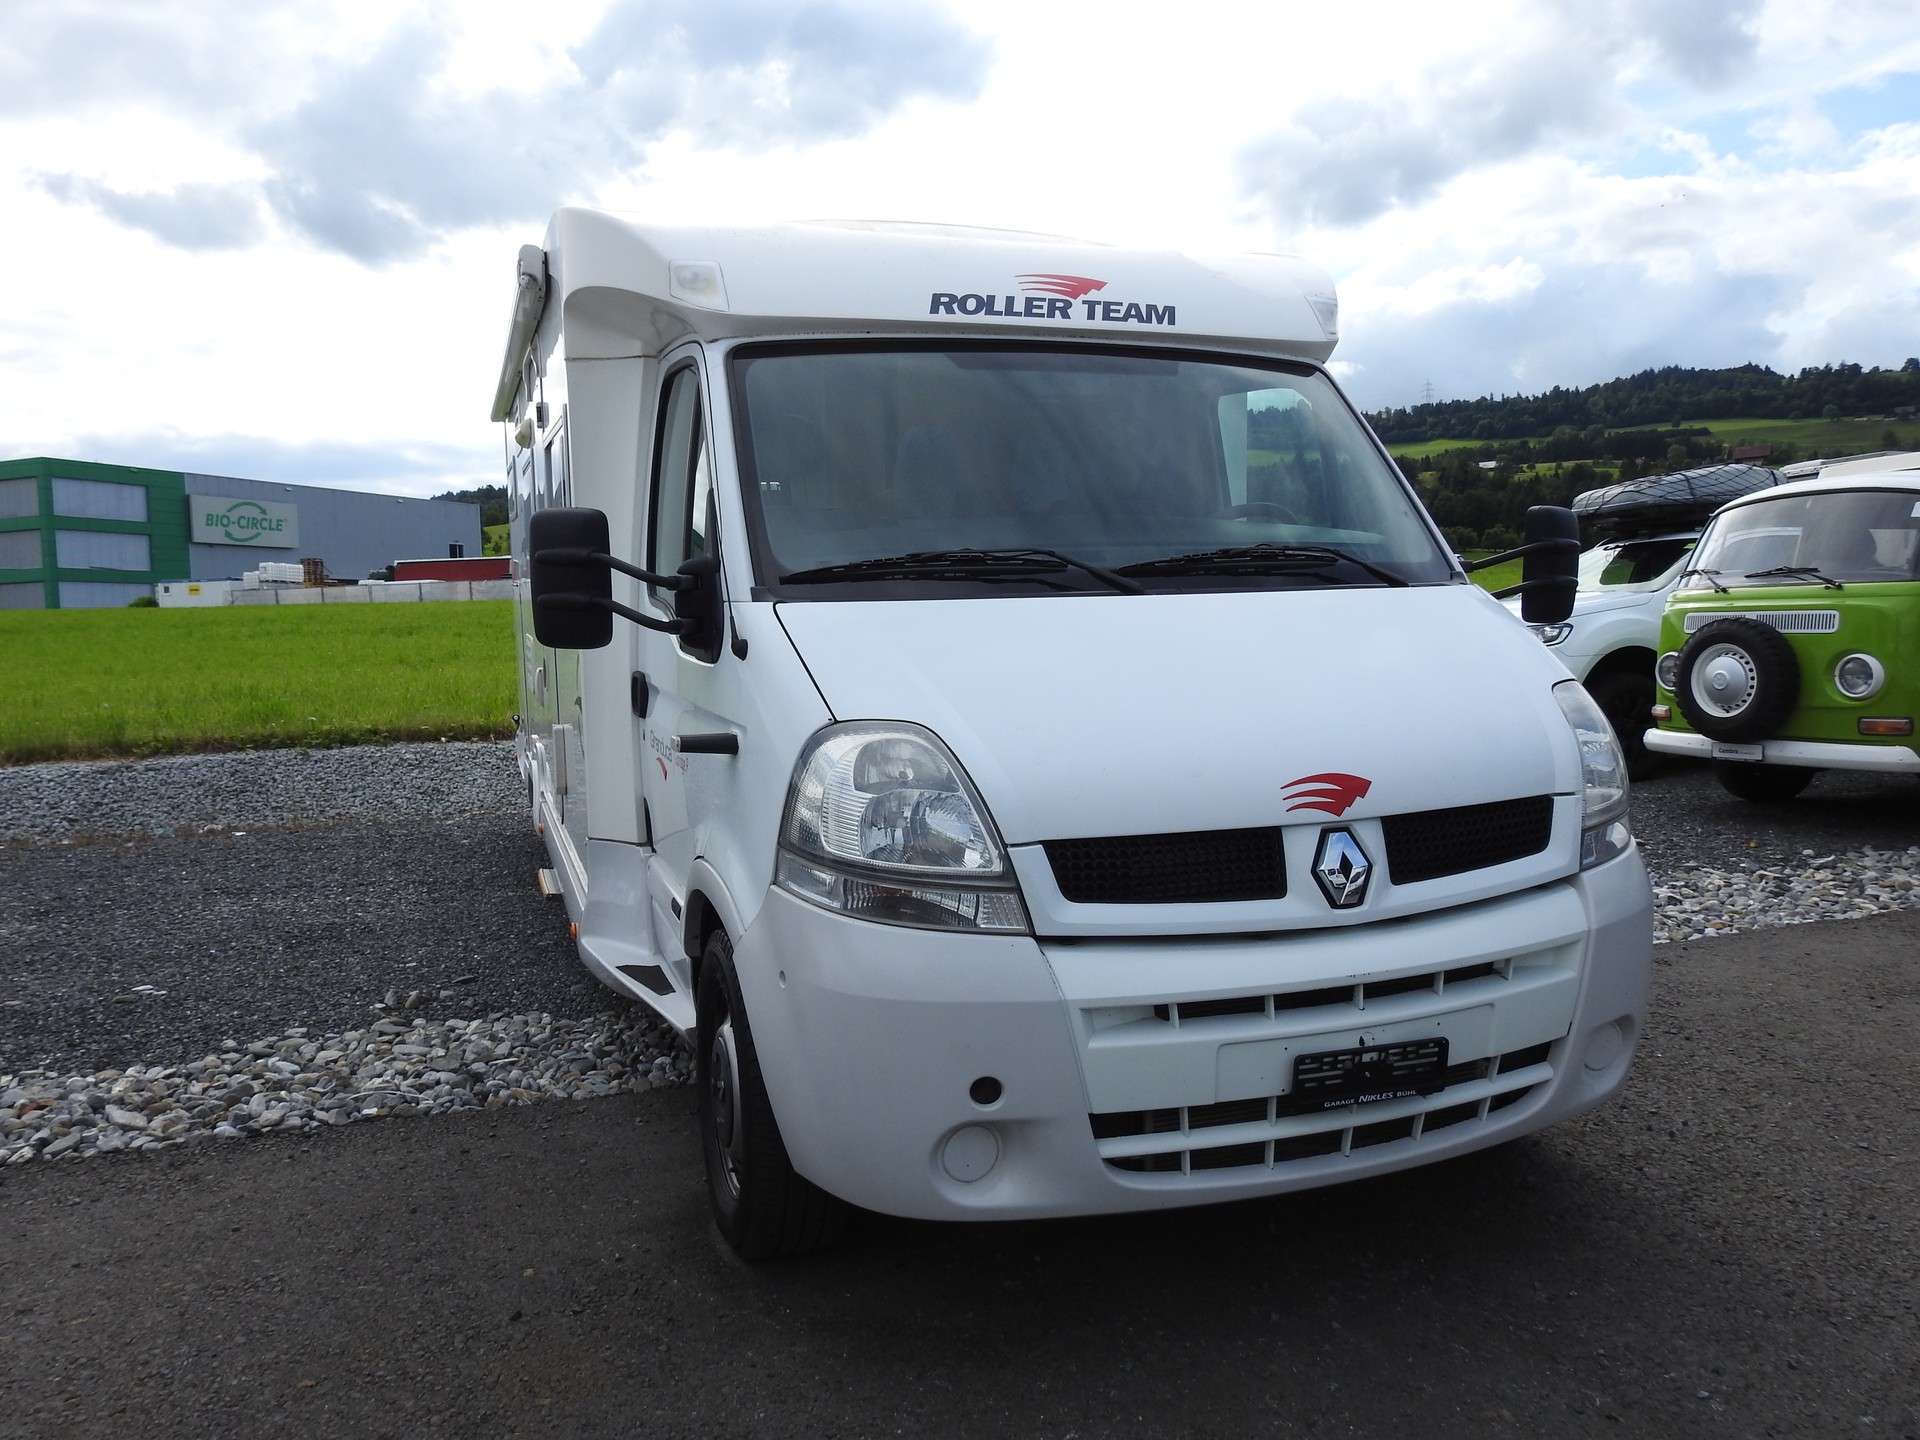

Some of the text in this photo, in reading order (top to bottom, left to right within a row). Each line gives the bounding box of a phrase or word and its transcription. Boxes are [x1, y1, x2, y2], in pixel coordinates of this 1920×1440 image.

[929, 293, 1176, 326] ROLLER TEAM
[205, 512, 284, 532] BIO-CIRCLE
[1323, 1098, 1355, 1108] GARAGE
[1358, 1091, 1394, 1103] NIKLES
